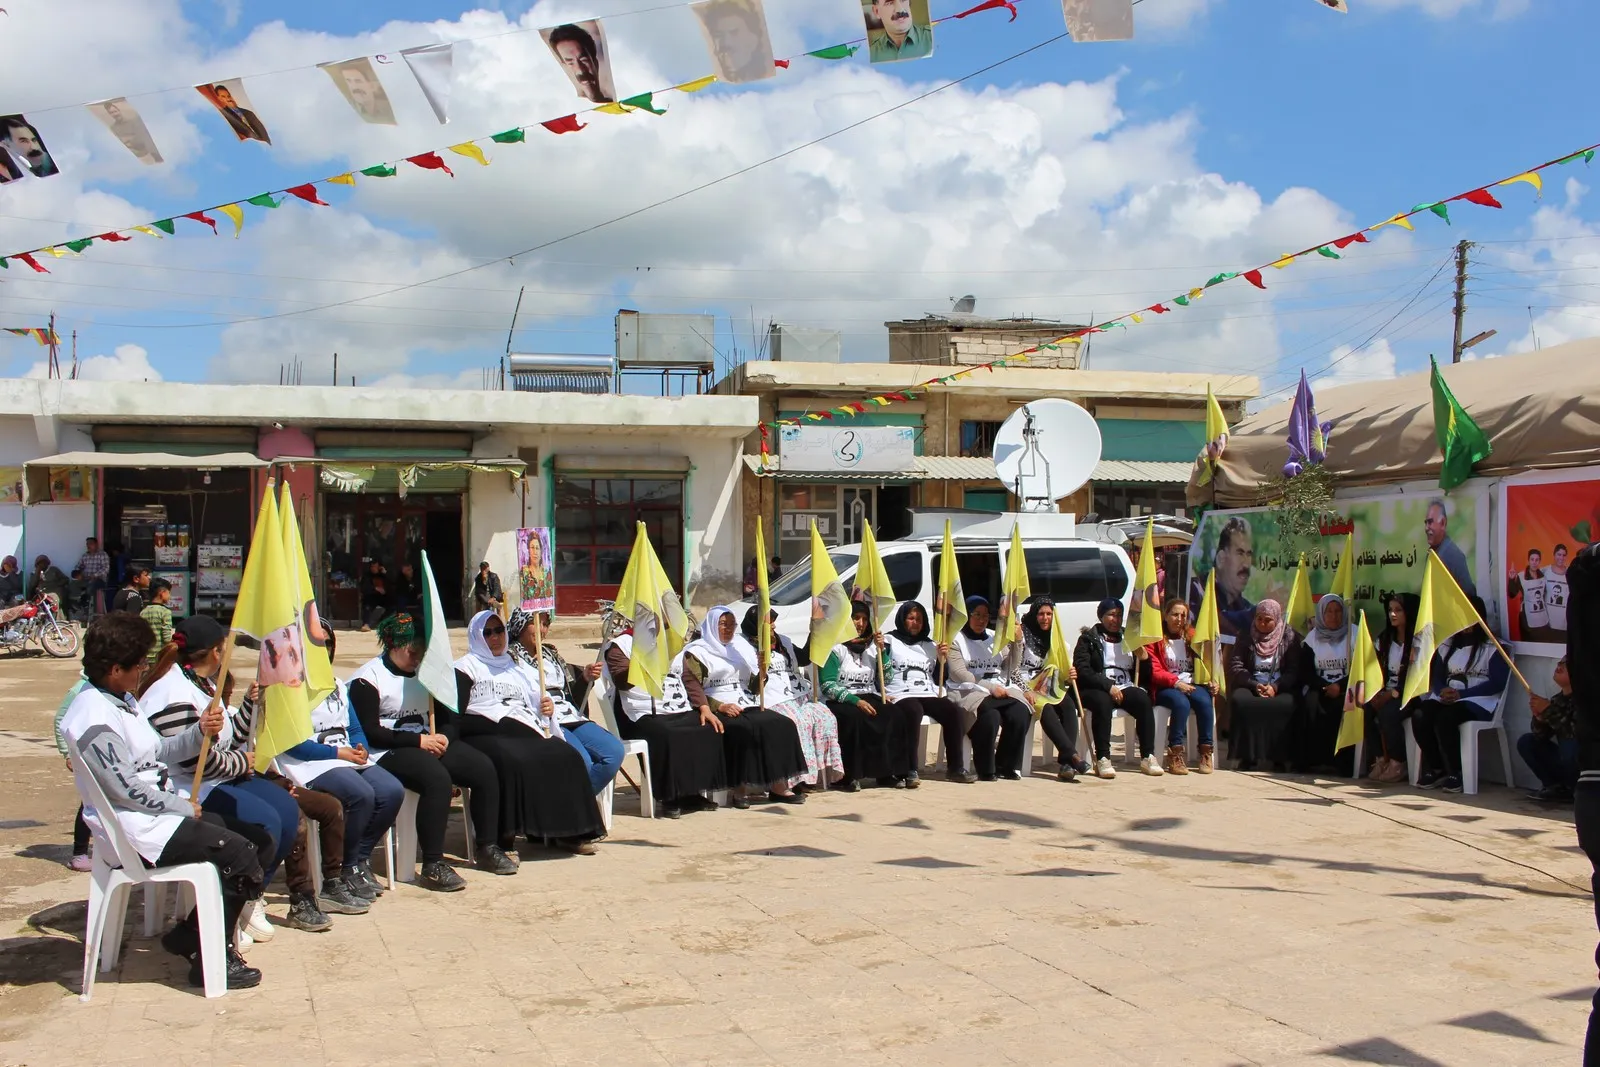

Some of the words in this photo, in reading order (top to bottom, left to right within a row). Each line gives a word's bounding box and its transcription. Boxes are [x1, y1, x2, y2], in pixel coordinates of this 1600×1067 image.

[1356, 550, 1377, 571] نظام
[1379, 550, 1403, 569] نحطم
[1406, 544, 1417, 568] أن
